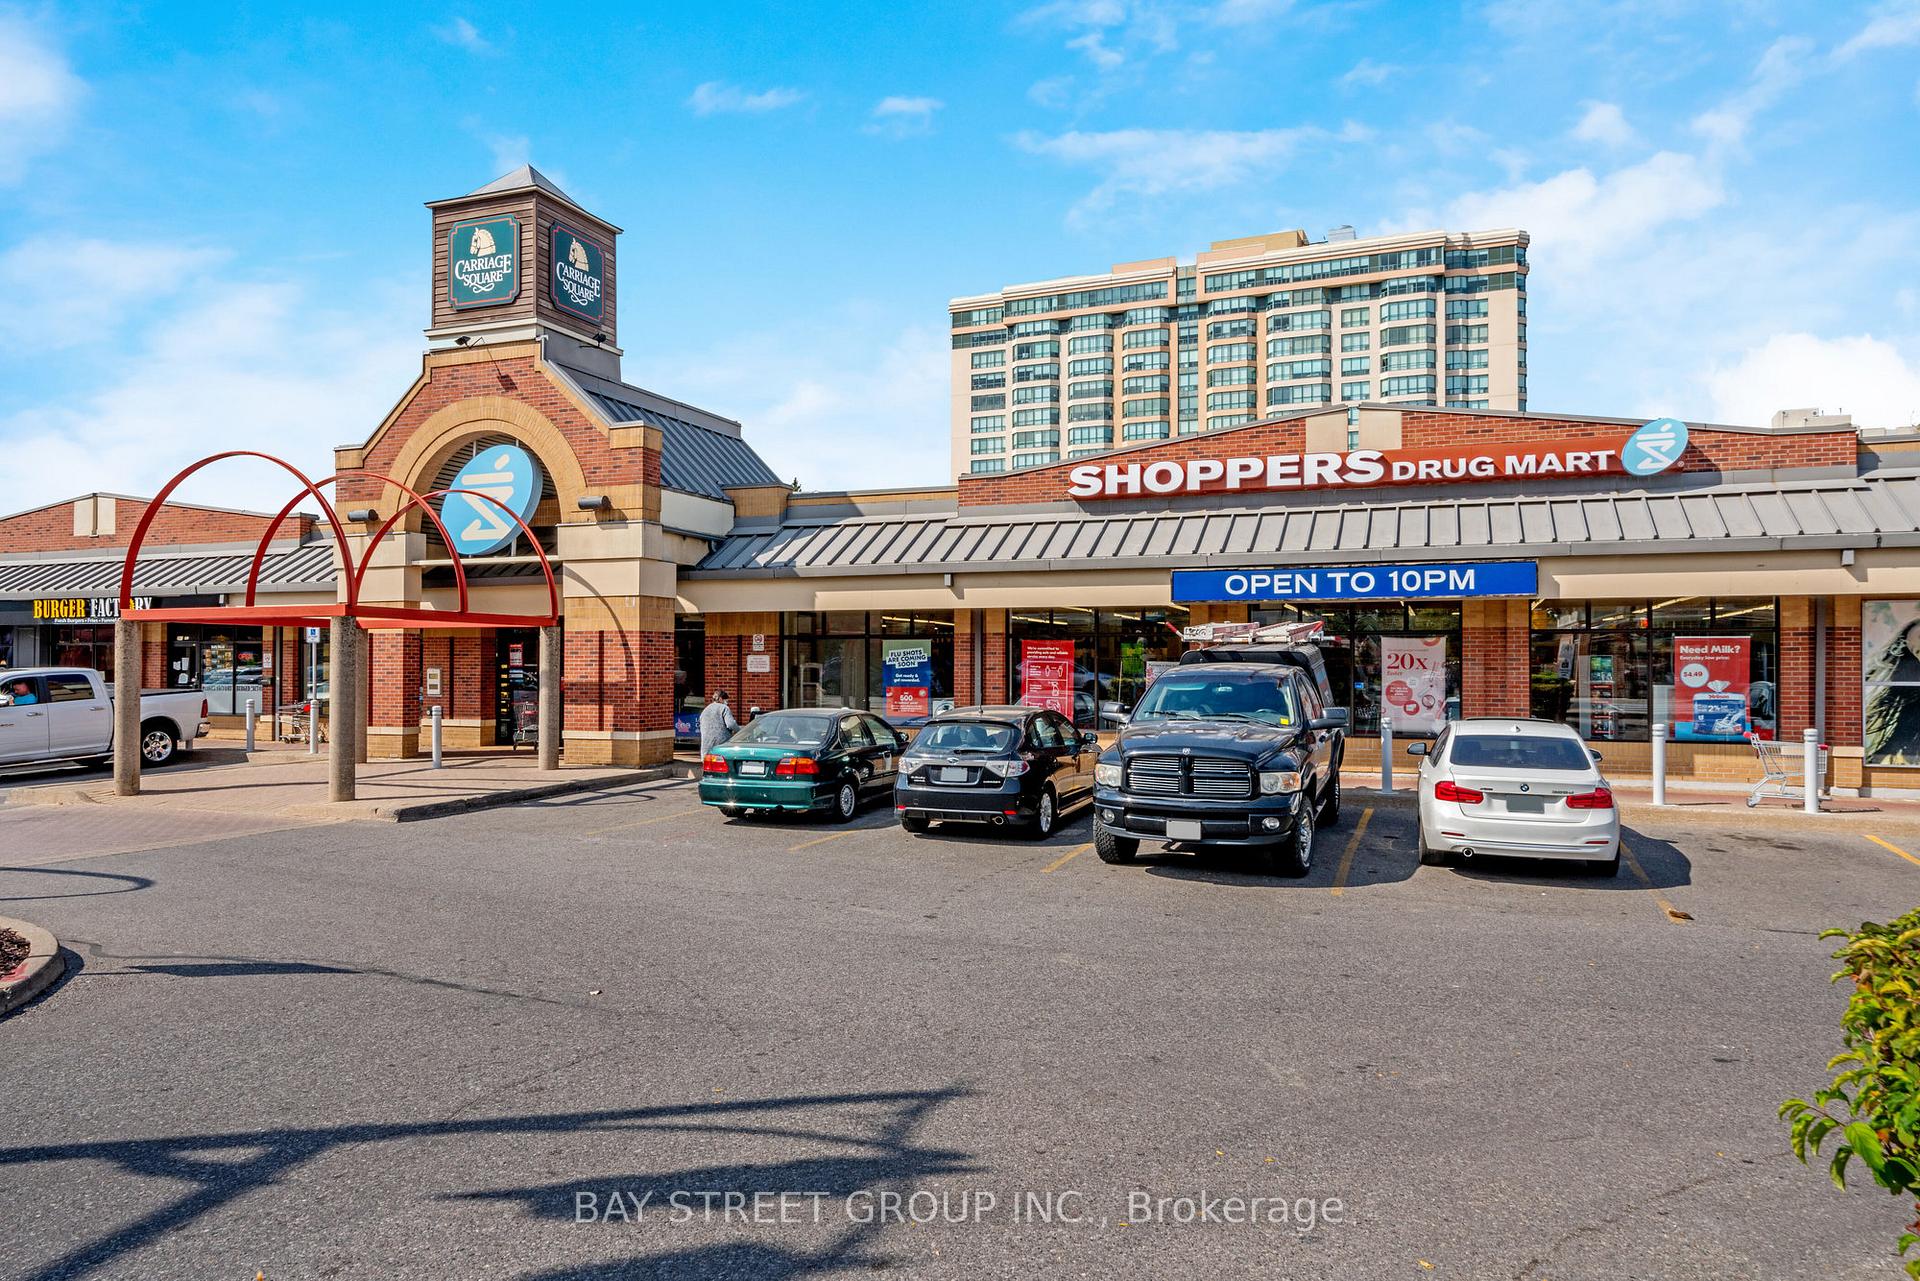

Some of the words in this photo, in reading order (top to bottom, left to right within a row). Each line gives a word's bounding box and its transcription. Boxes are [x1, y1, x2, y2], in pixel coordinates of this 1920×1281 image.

[455, 254, 512, 280] CARRIAGE
[463, 270, 503, 293] SQUARE
[556, 262, 601, 298] CARRIAGE
[563, 280, 594, 305] SQUARE
[1067, 449, 1385, 497] SHOPPERS
[1392, 456, 1495, 481] DRUG
[1505, 450, 1616, 475] MART
[1224, 572, 1317, 595] OPEN
[1327, 570, 1375, 593] TO
[1388, 569, 1475, 592] 10PM
[33, 599, 86, 619] BURGER
[90, 597, 152, 618] FACTRY
[900, 654, 926, 662] COMING
[903, 649, 923, 657] SHOTS
[1680, 645, 1708, 653] Need
[1710, 645, 1741, 653] Milk?
[1387, 653, 1428, 670] 20x
